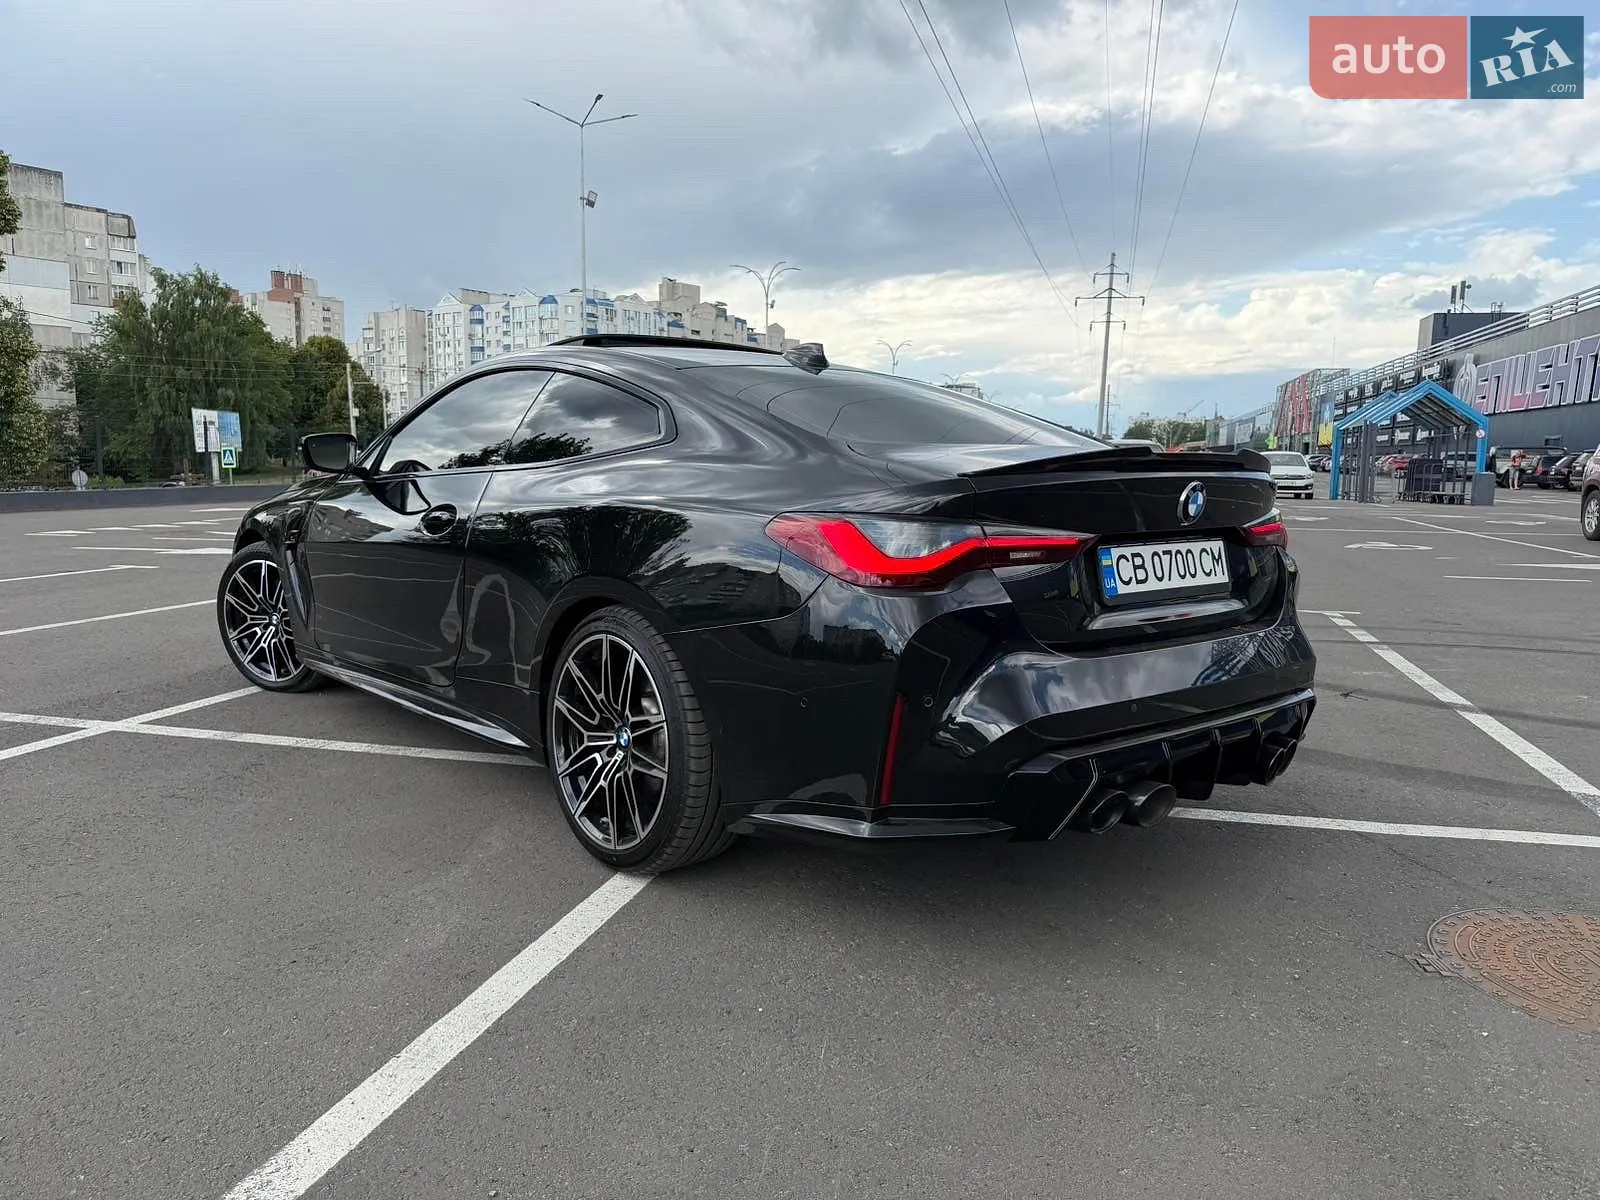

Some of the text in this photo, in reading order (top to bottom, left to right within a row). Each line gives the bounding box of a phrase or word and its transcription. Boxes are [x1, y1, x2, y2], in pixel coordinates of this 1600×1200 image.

[1116, 547, 1225, 585] CB 0700 CM
[1105, 577, 1116, 589] UA
